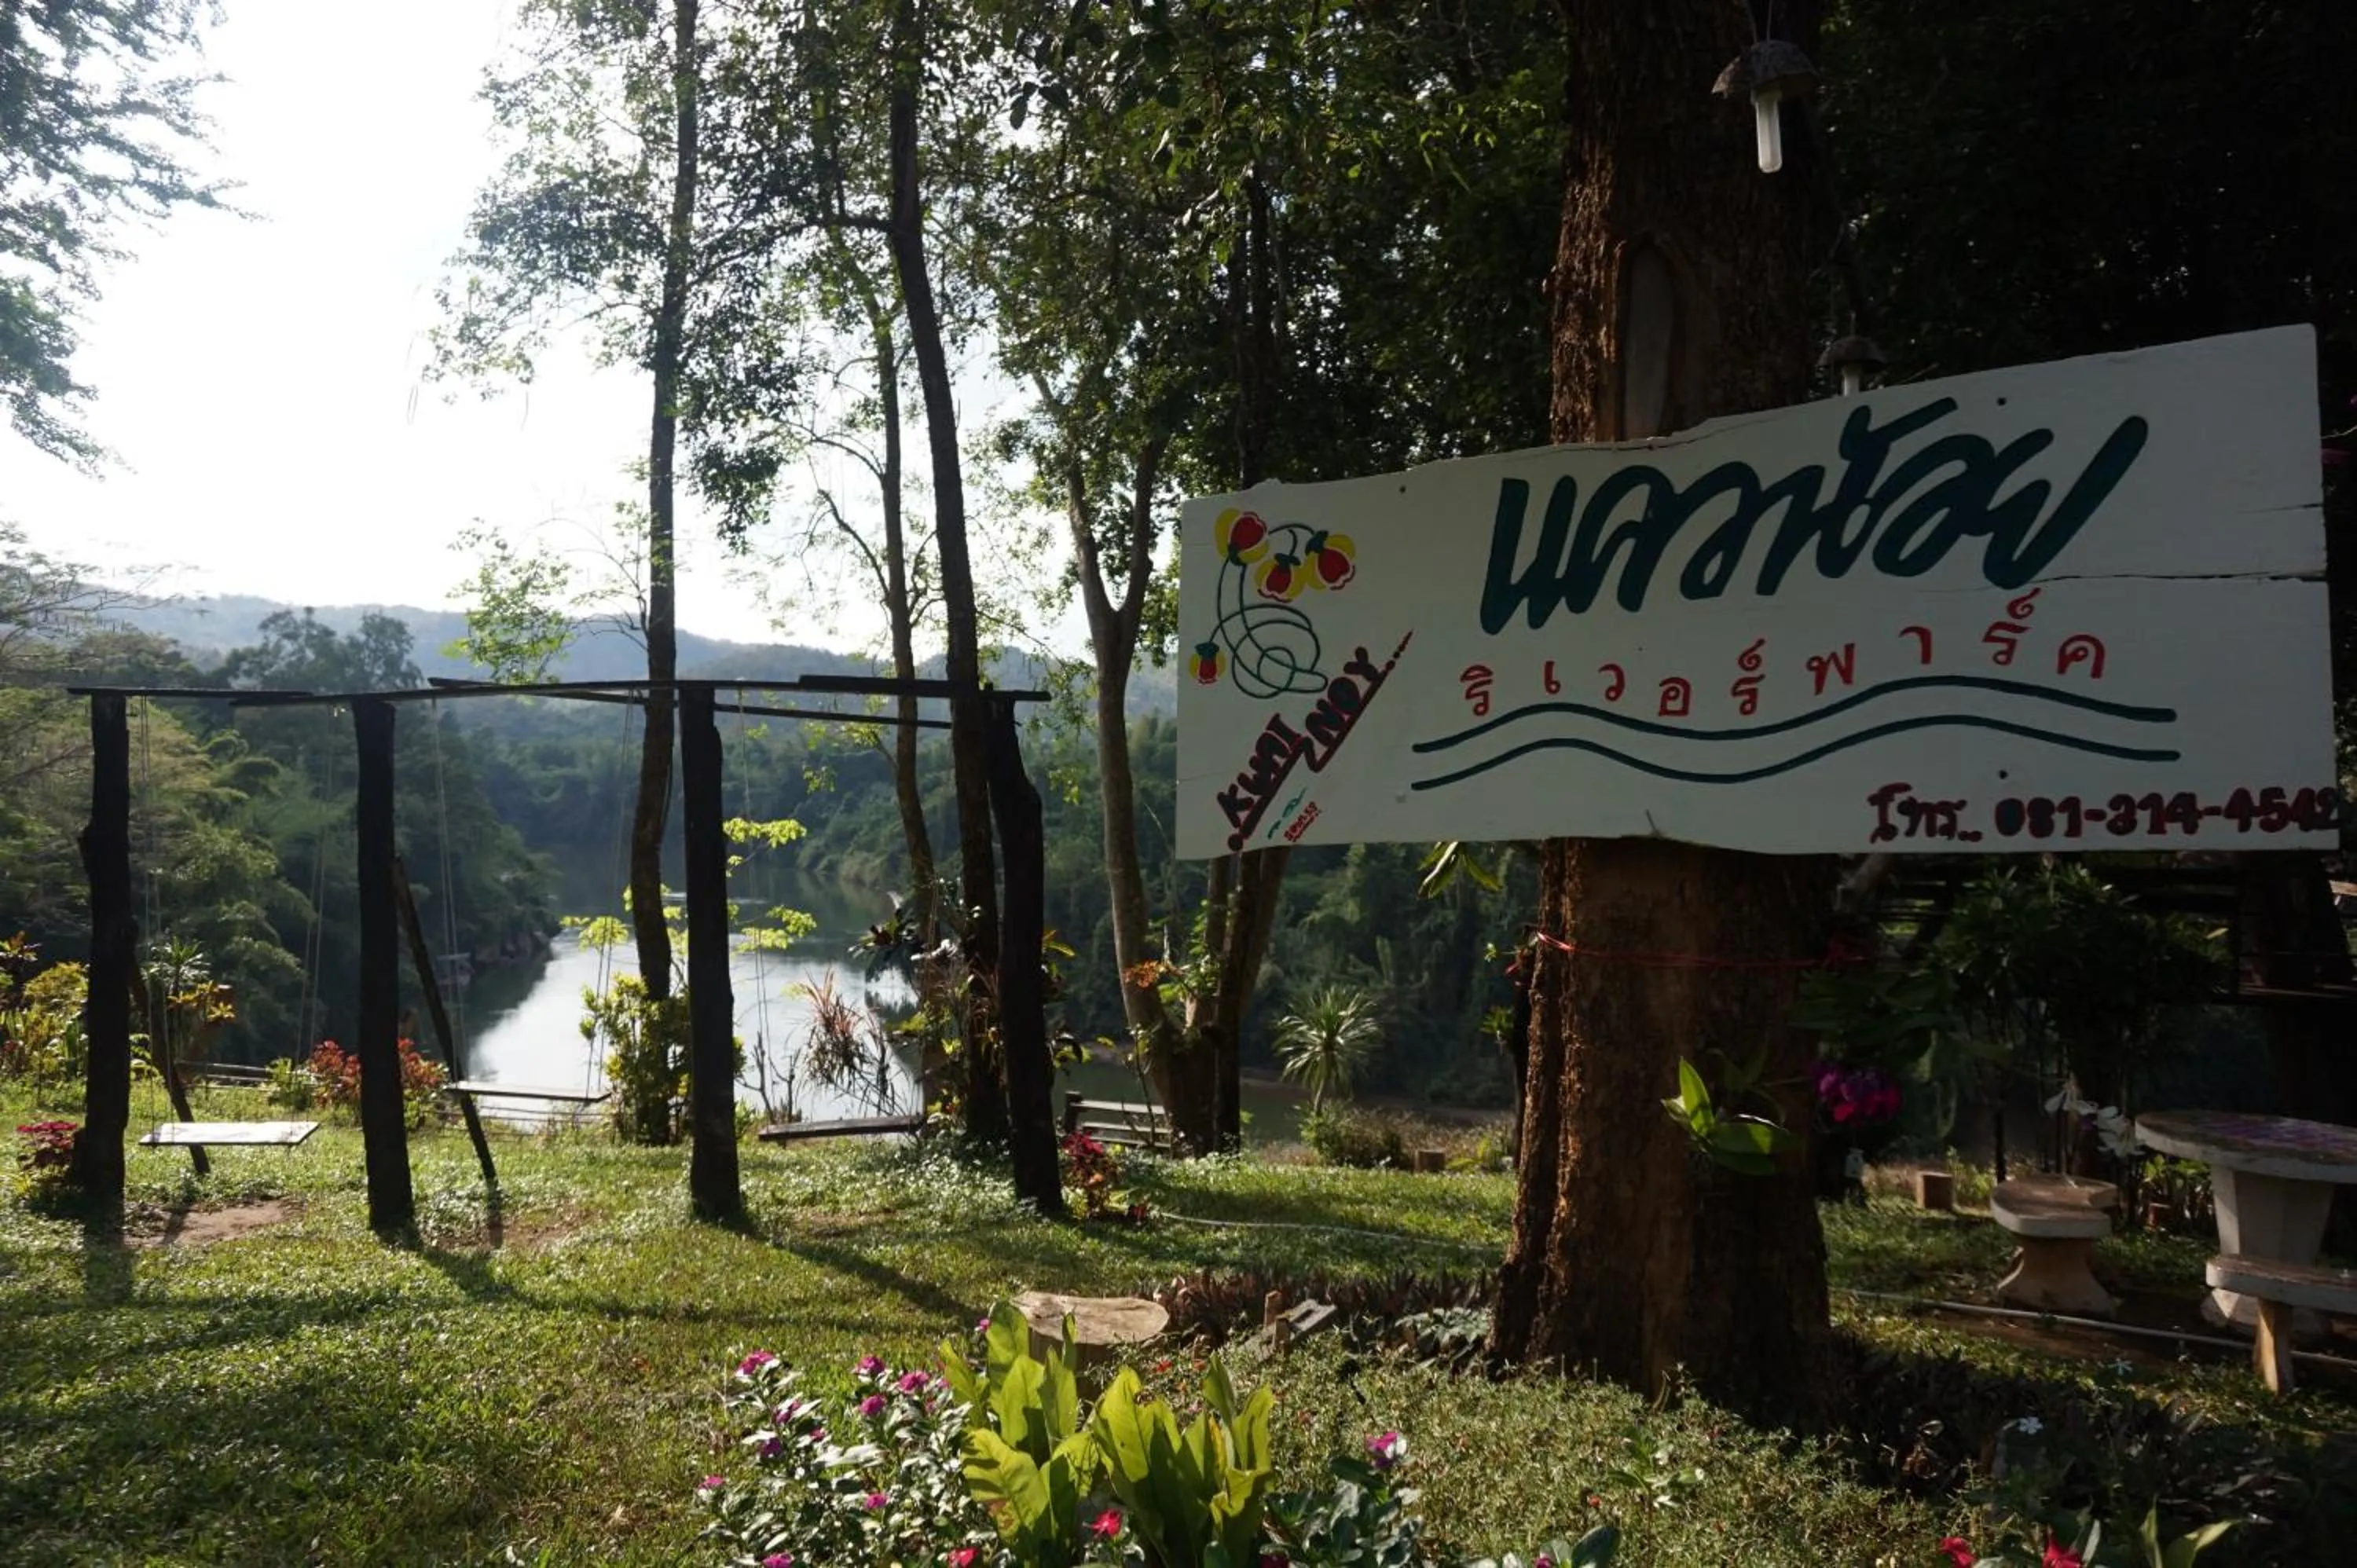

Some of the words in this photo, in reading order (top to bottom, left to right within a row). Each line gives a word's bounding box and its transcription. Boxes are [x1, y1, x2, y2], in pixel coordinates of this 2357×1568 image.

[1480, 397, 2148, 635] แควน้อย
[1305, 647, 1380, 746] NOY
[1217, 713, 1303, 829] KWAI
